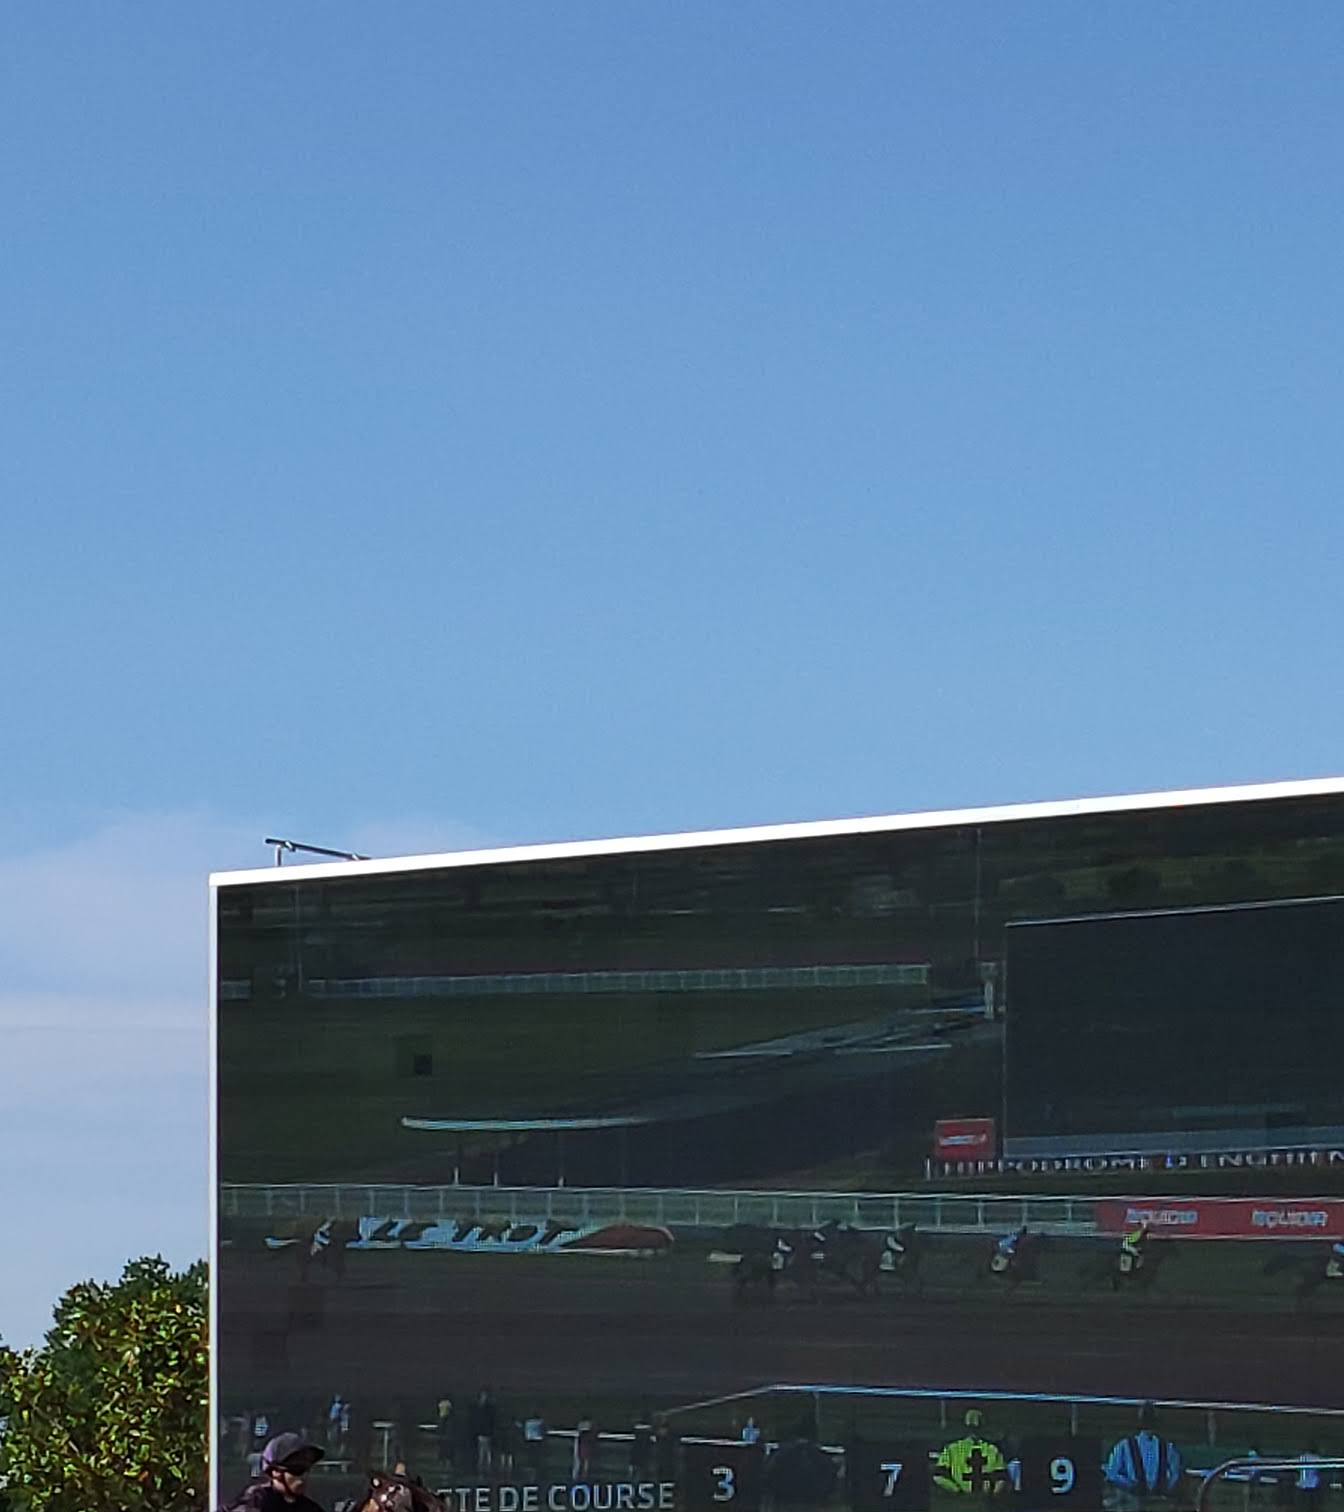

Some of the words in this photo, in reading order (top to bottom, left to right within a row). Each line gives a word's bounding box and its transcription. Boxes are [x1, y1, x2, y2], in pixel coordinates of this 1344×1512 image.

[498, 1486, 539, 1512] DE
[548, 1482, 676, 1511] COURSE
[711, 1467, 736, 1502] 3
[879, 1463, 904, 1497] 7
[1049, 1456, 1077, 1494] 9
